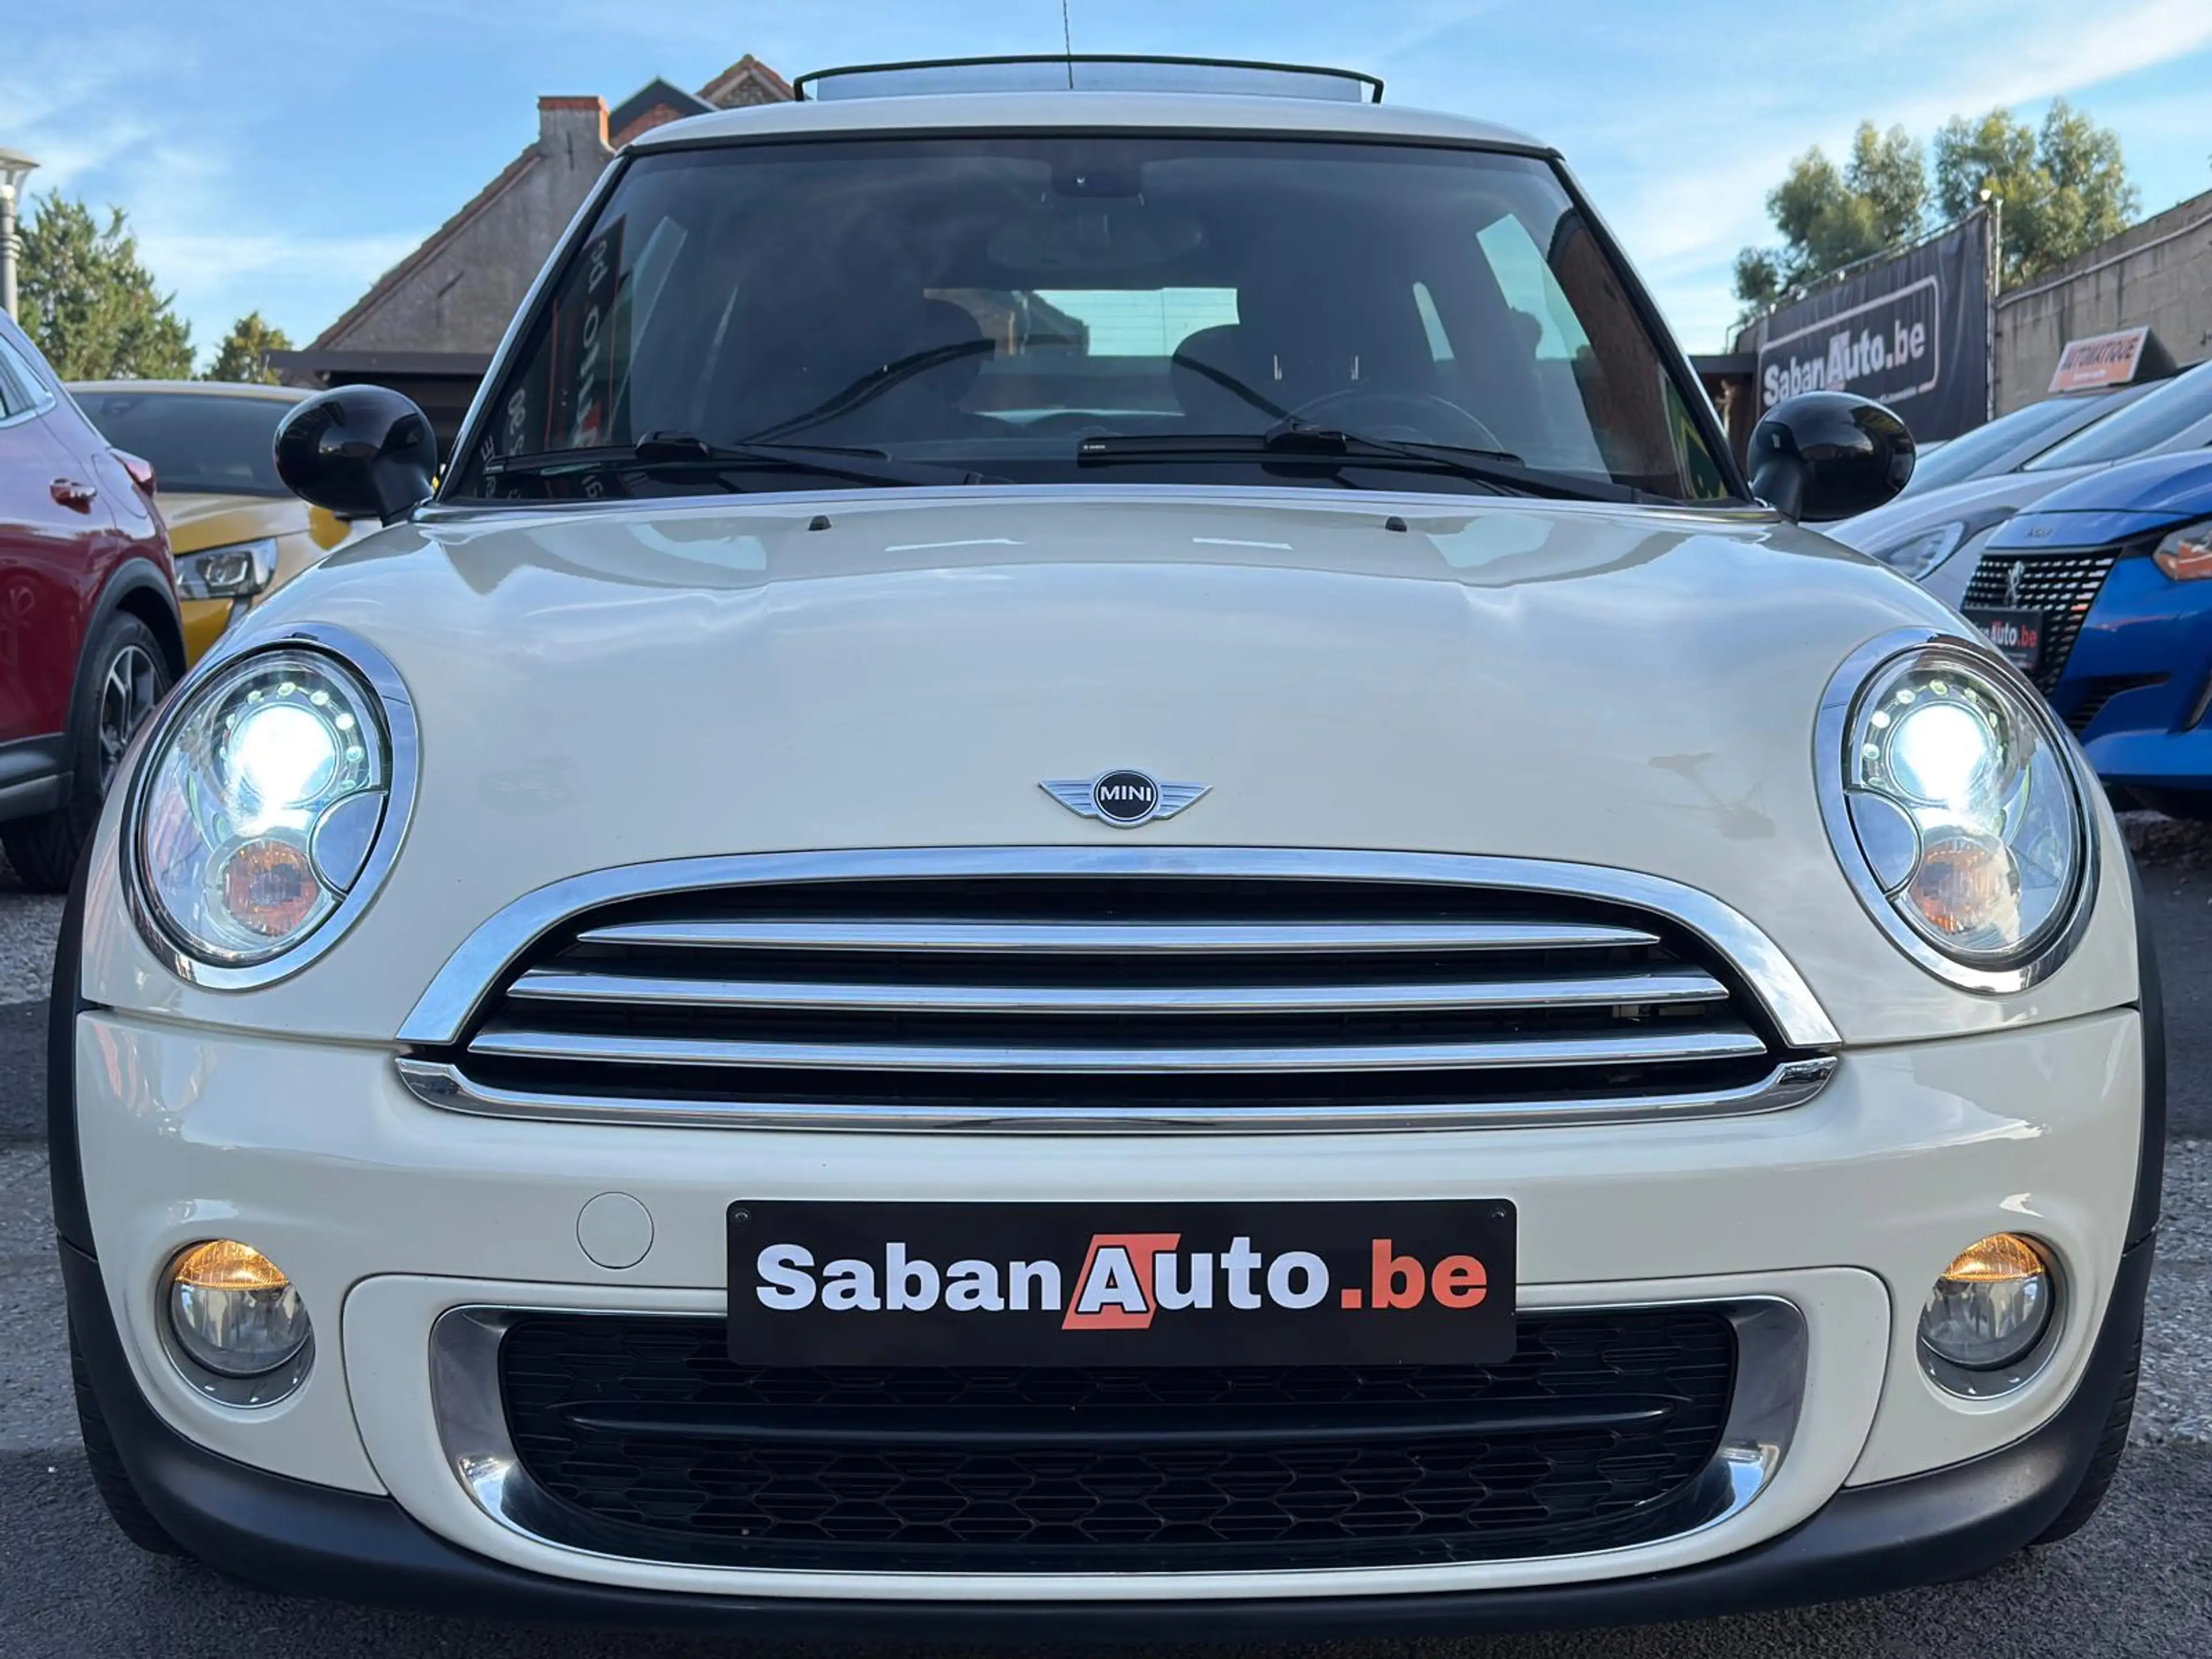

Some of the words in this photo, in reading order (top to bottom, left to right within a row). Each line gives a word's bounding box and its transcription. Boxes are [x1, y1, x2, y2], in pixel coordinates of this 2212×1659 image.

[1763, 319, 1926, 407] SabanAuto.be
[1100, 785, 1152, 802] MINI
[756, 1236, 1487, 1315] SabanAuto.be
